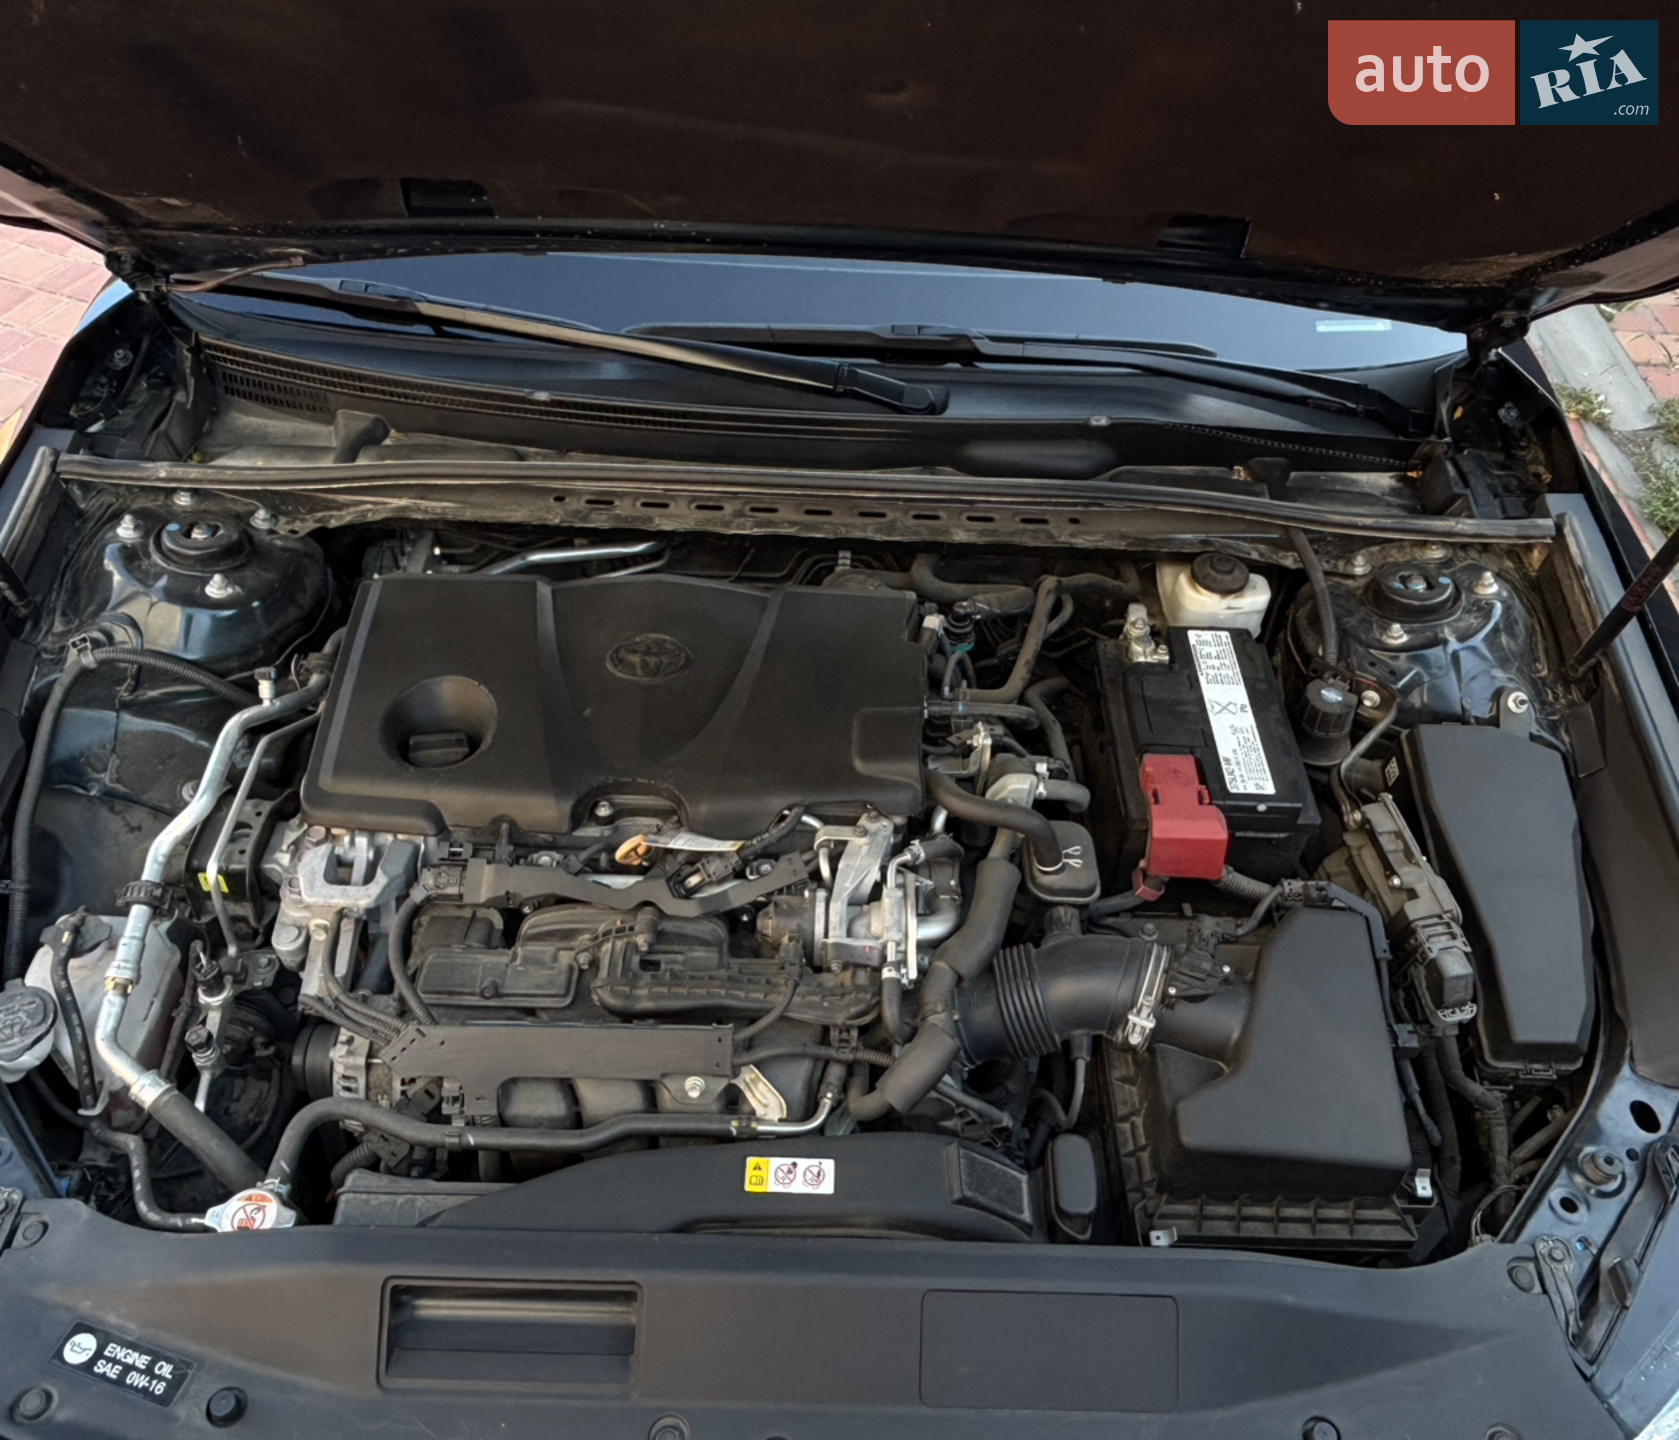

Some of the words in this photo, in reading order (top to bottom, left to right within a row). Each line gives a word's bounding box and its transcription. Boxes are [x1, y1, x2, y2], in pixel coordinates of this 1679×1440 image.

[93, 1359, 123, 1380] SAE
[125, 1370, 167, 1395] 0W-16
[103, 1342, 152, 1370] ENGINE
[154, 1360, 174, 1380] OIL
